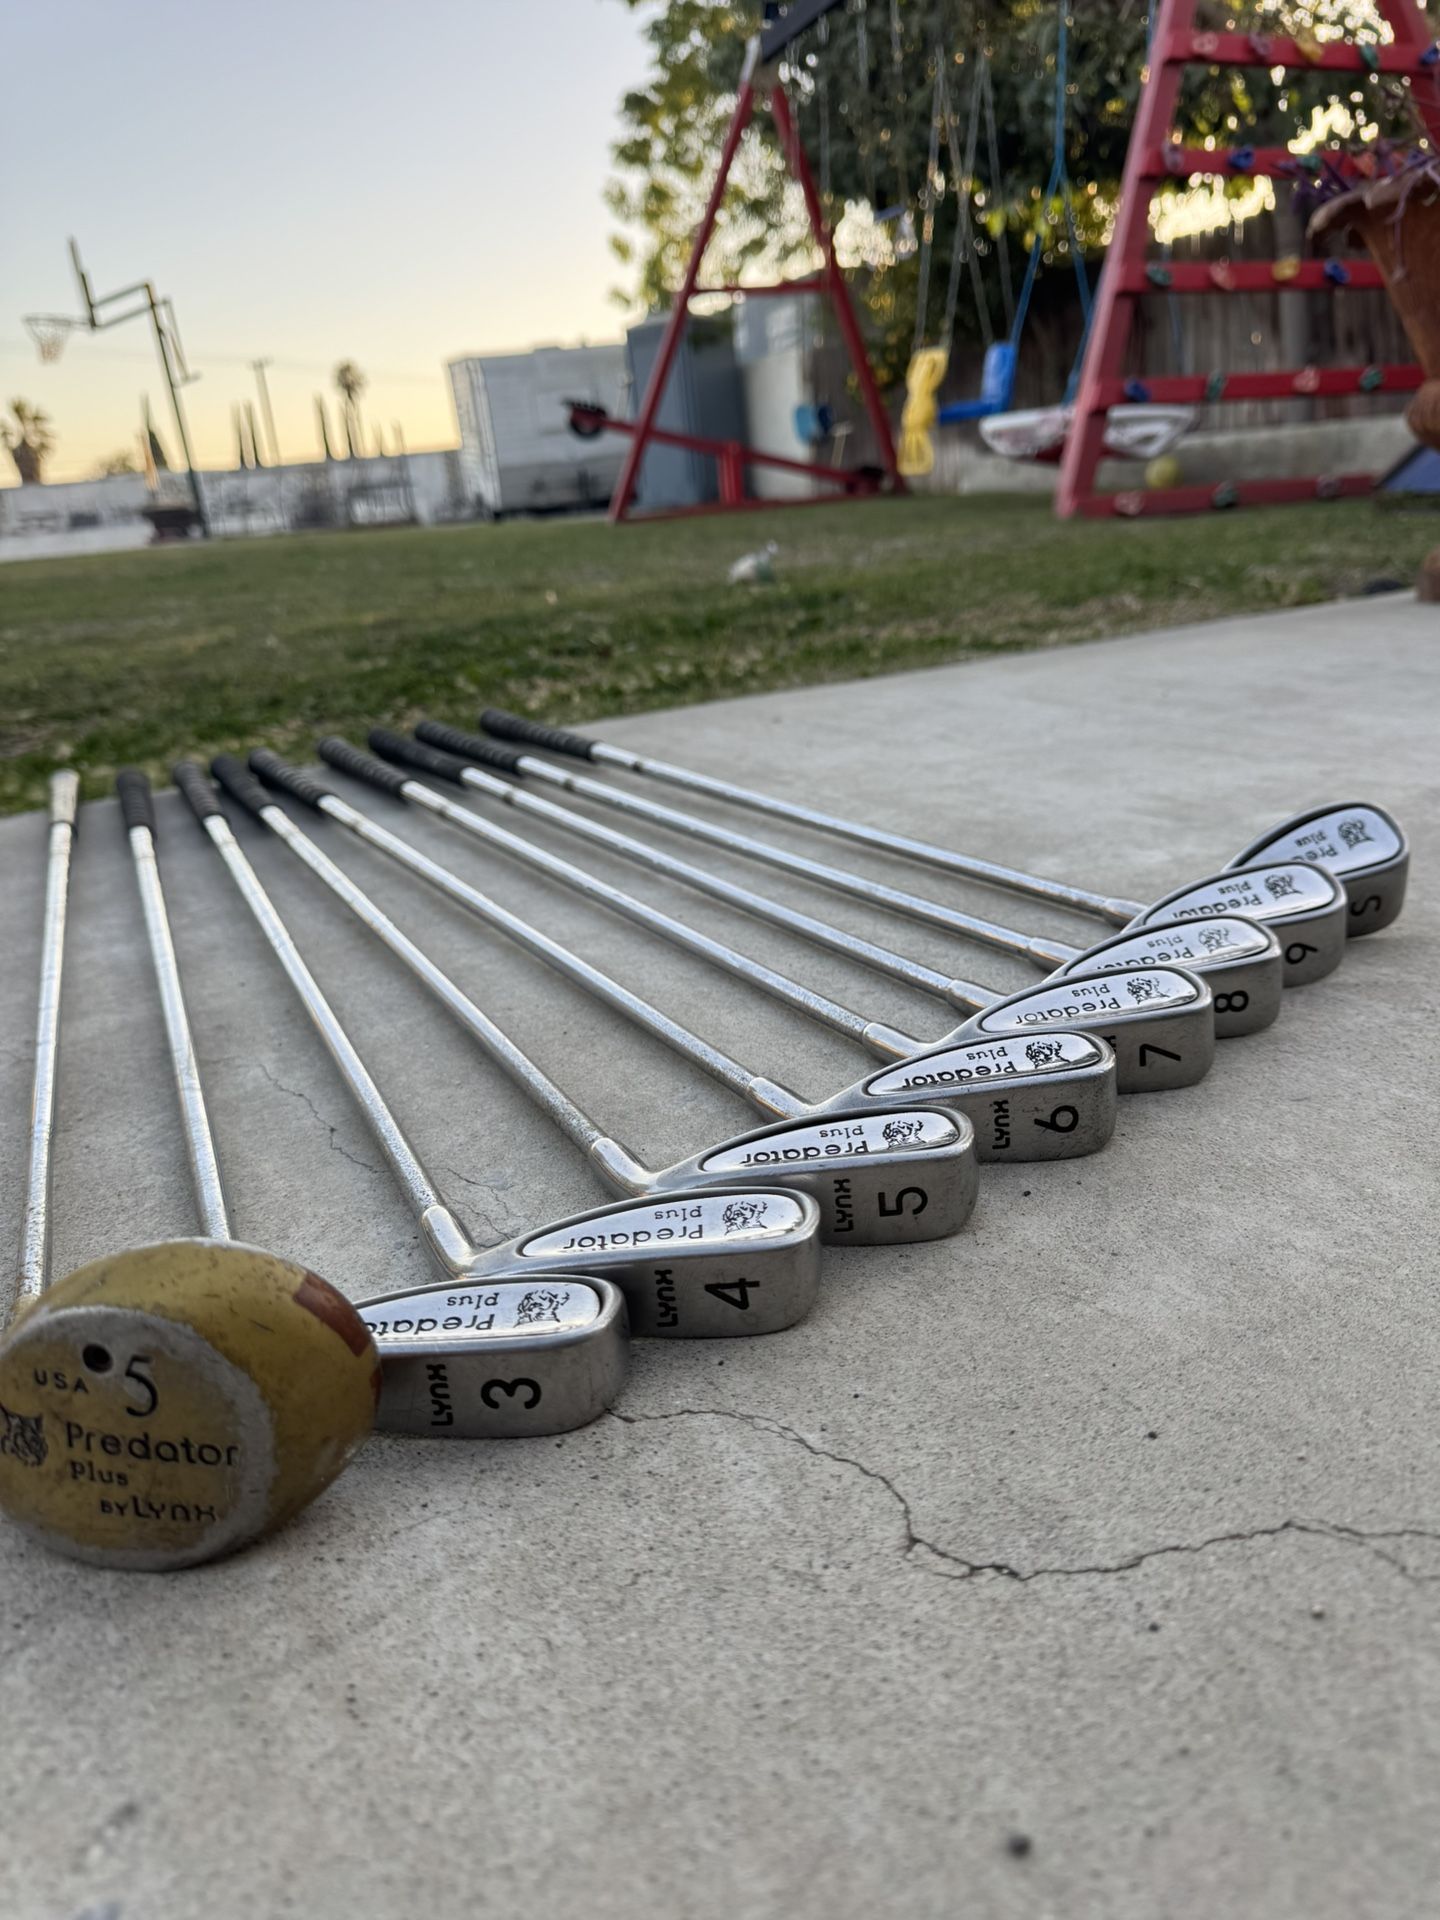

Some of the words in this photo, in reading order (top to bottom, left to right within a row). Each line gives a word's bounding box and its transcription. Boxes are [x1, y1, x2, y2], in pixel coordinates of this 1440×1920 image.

[1350, 895, 1381, 917] S
[1284, 942, 1318, 965] 9
[1071, 983, 1111, 998] plus
[1213, 990, 1249, 1014] 8
[1015, 996, 1122, 1025] Predator
[966, 1046, 1009, 1061] plus
[1139, 1043, 1181, 1067] 7
[902, 1060, 1018, 1089] Predator
[1034, 1104, 1079, 1133] 6
[819, 1125, 864, 1139] plus
[740, 1140, 870, 1165] Predator
[654, 1205, 702, 1221] plus
[878, 1186, 929, 1218] 5
[563, 1224, 704, 1250] Predator
[447, 1292, 500, 1310] plus
[704, 1278, 760, 1310] 4
[33, 1370, 89, 1394] USA
[125, 1354, 159, 1417] 5
[480, 1377, 542, 1410] 3
[66, 1421, 239, 1466] Predator
